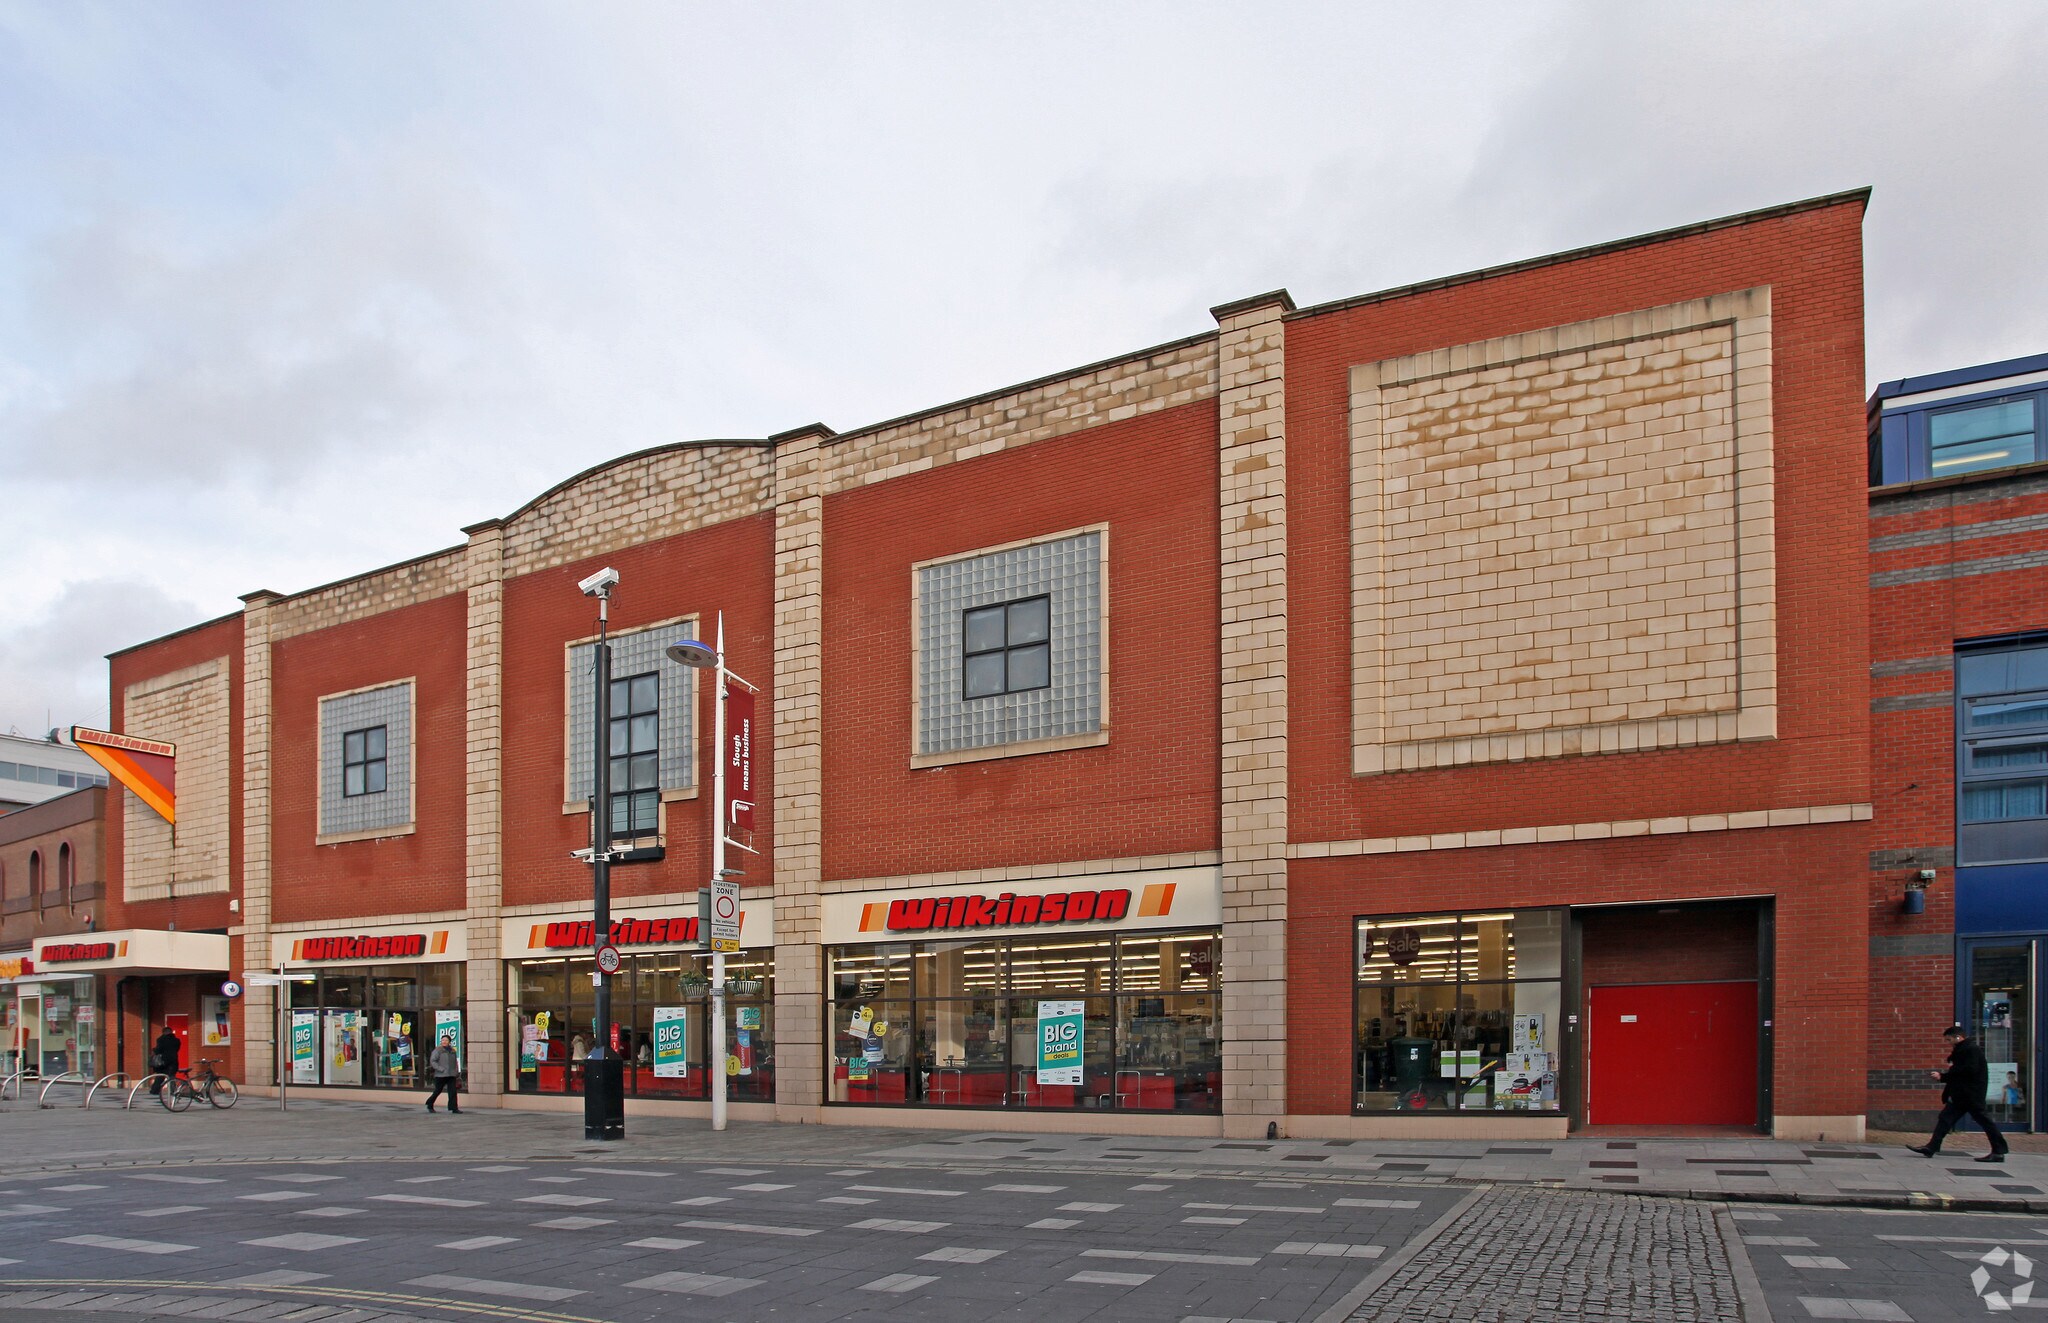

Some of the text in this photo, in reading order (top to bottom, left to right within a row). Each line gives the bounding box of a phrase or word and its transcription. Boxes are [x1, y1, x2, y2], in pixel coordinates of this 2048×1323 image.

[732, 734, 741, 767] Slough
[886, 888, 1132, 932] Wilkinson
[302, 934, 424, 961] Wilkinson
[1389, 933, 1420, 952] sale
[295, 1028, 311, 1043] BIG
[659, 1025, 681, 1042] BIG
[1044, 1022, 1077, 1042] BIG
[659, 1040, 681, 1051] brand
[1044, 1040, 1077, 1054] brand
[849, 1057, 869, 1069] BIG
